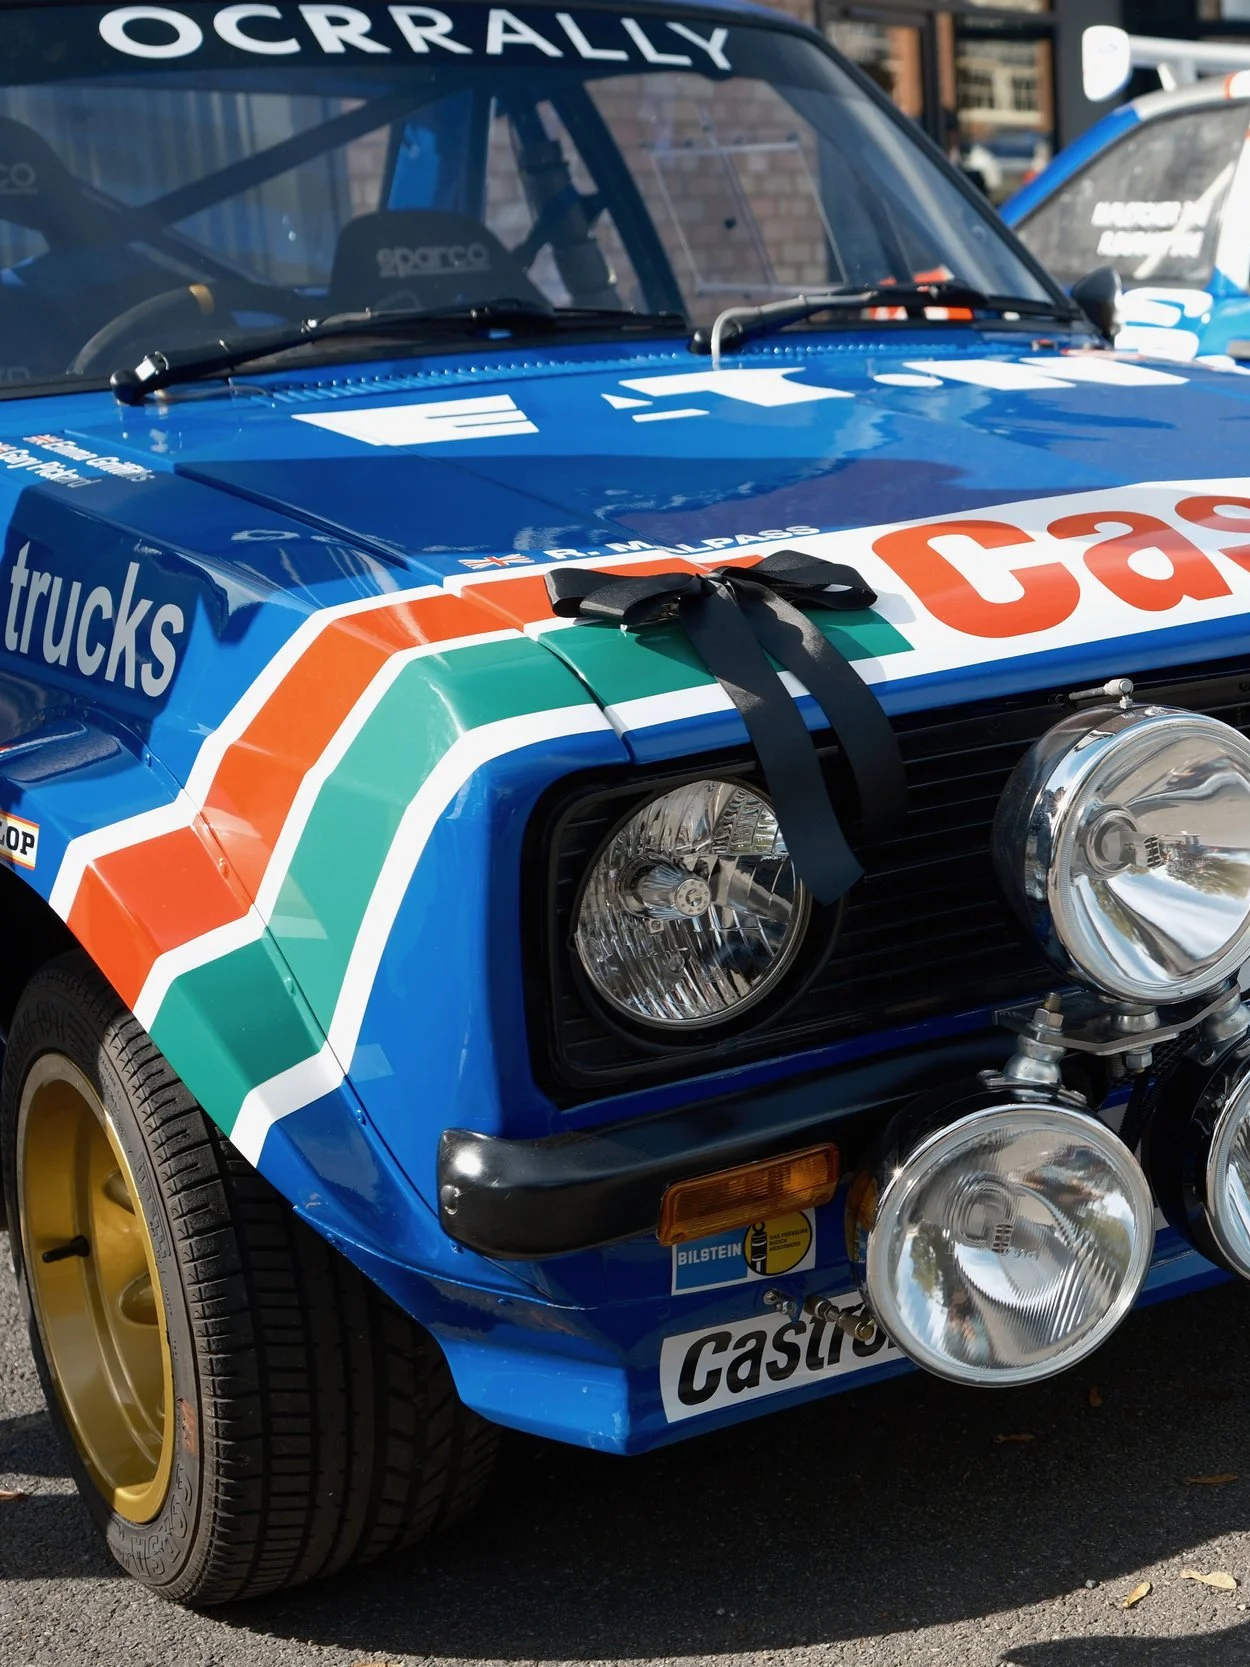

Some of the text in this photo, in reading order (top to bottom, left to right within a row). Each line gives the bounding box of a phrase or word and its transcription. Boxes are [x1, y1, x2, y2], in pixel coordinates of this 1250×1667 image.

[376, 243, 490, 278] sparco
[543, 547, 600, 561] R.
[4, 540, 185, 698] trucks
[677, 1241, 742, 1266] BILSTEIN
[677, 1302, 898, 1406] Castro
